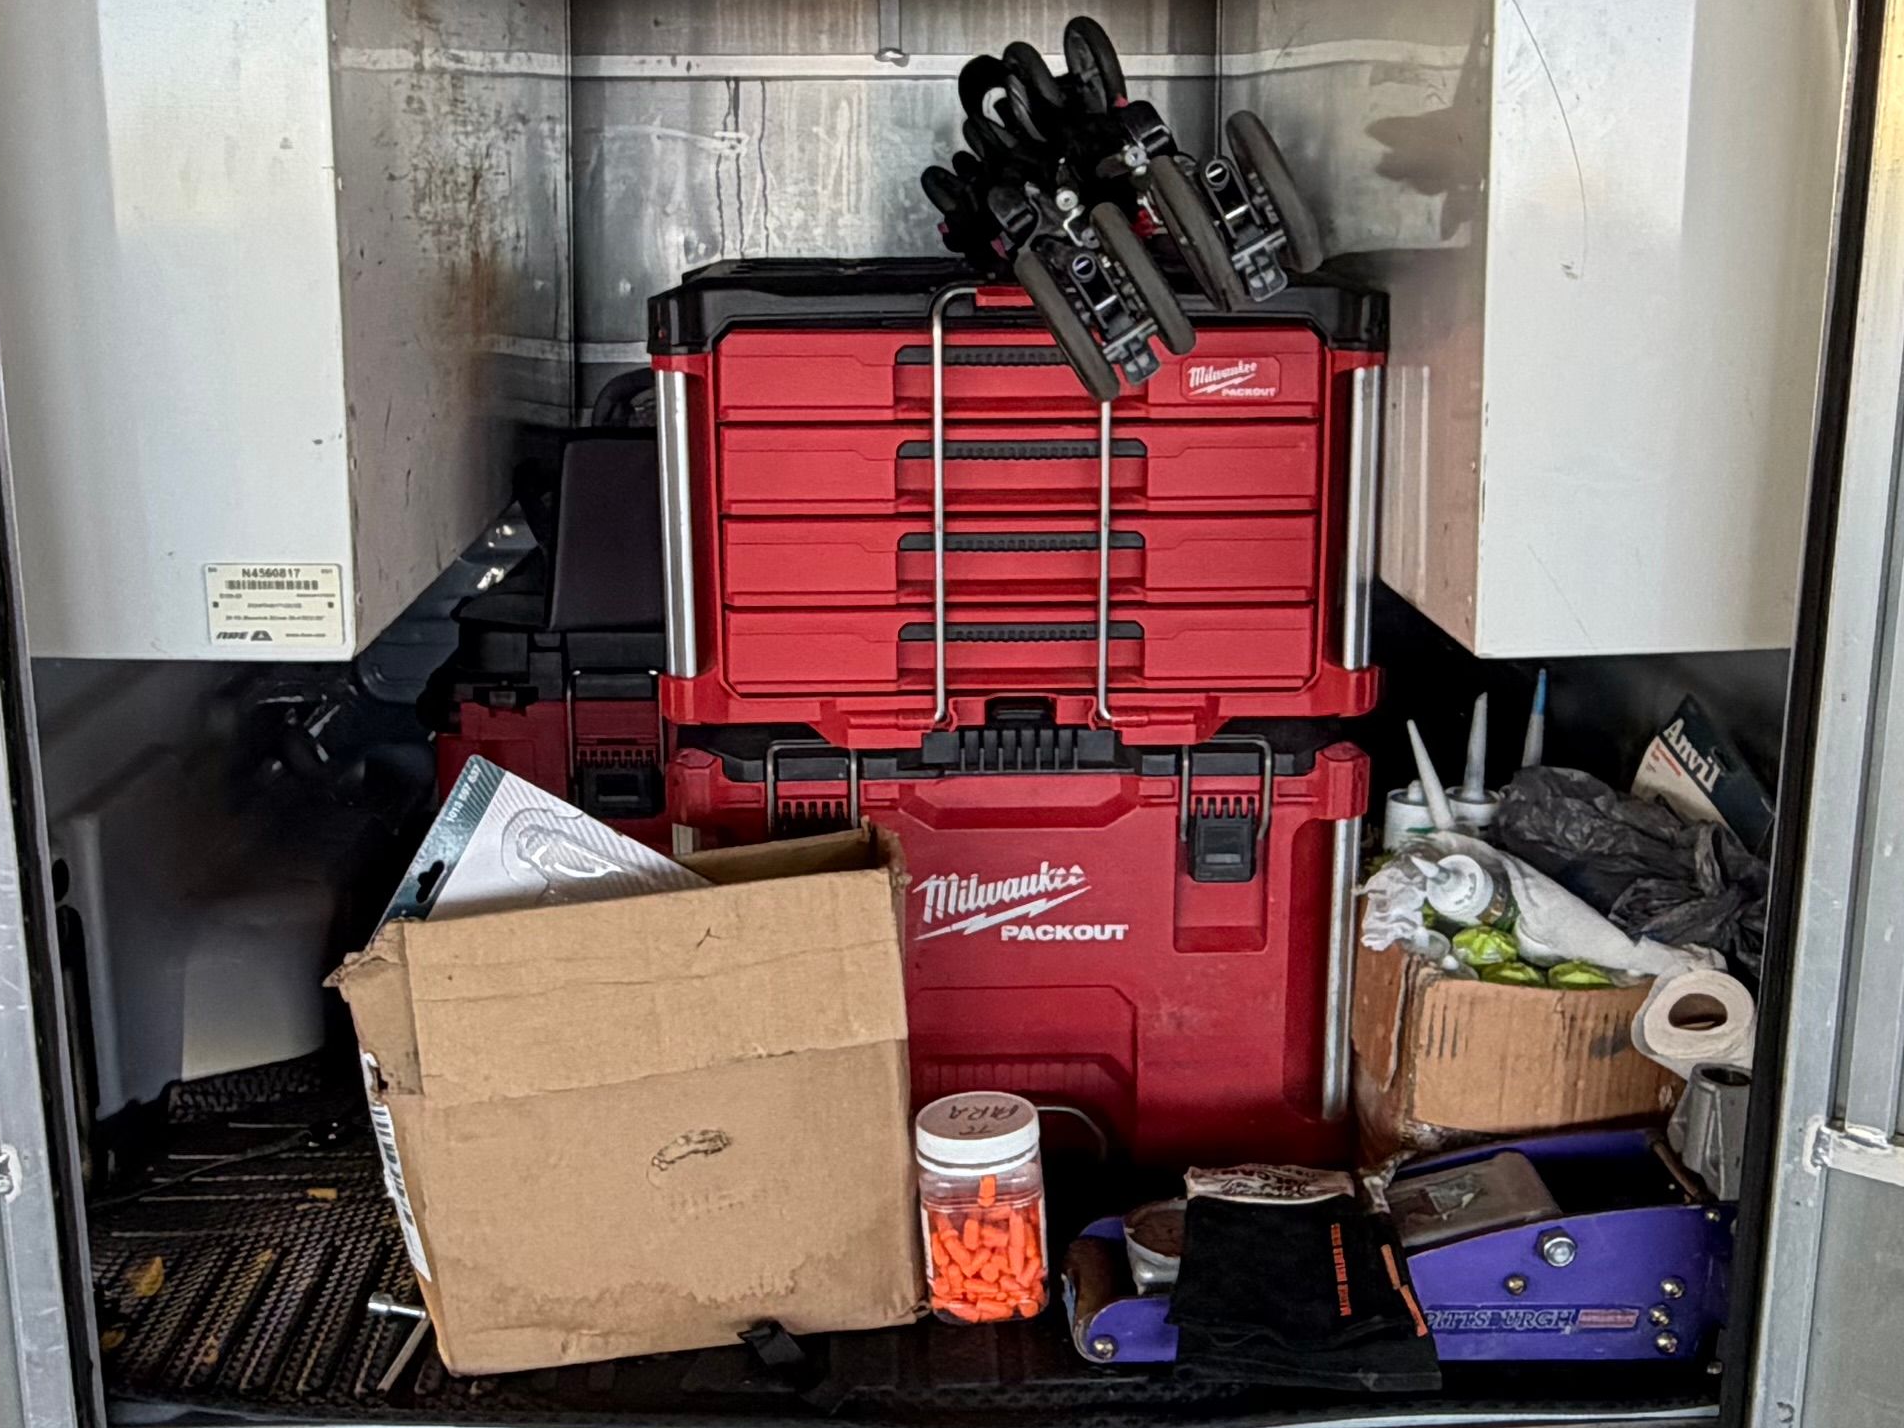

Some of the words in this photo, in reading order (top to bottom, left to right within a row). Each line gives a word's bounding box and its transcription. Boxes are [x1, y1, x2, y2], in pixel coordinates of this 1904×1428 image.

[1187, 360, 1258, 388] Milwaukee
[1221, 387, 1276, 396] PACKOUT
[1662, 717, 1721, 793] Anvil
[912, 861, 1087, 924] Milwaukee
[1000, 923, 1129, 941] PACKOUT
[1425, 1308, 1578, 1331] PITTSBURGH
